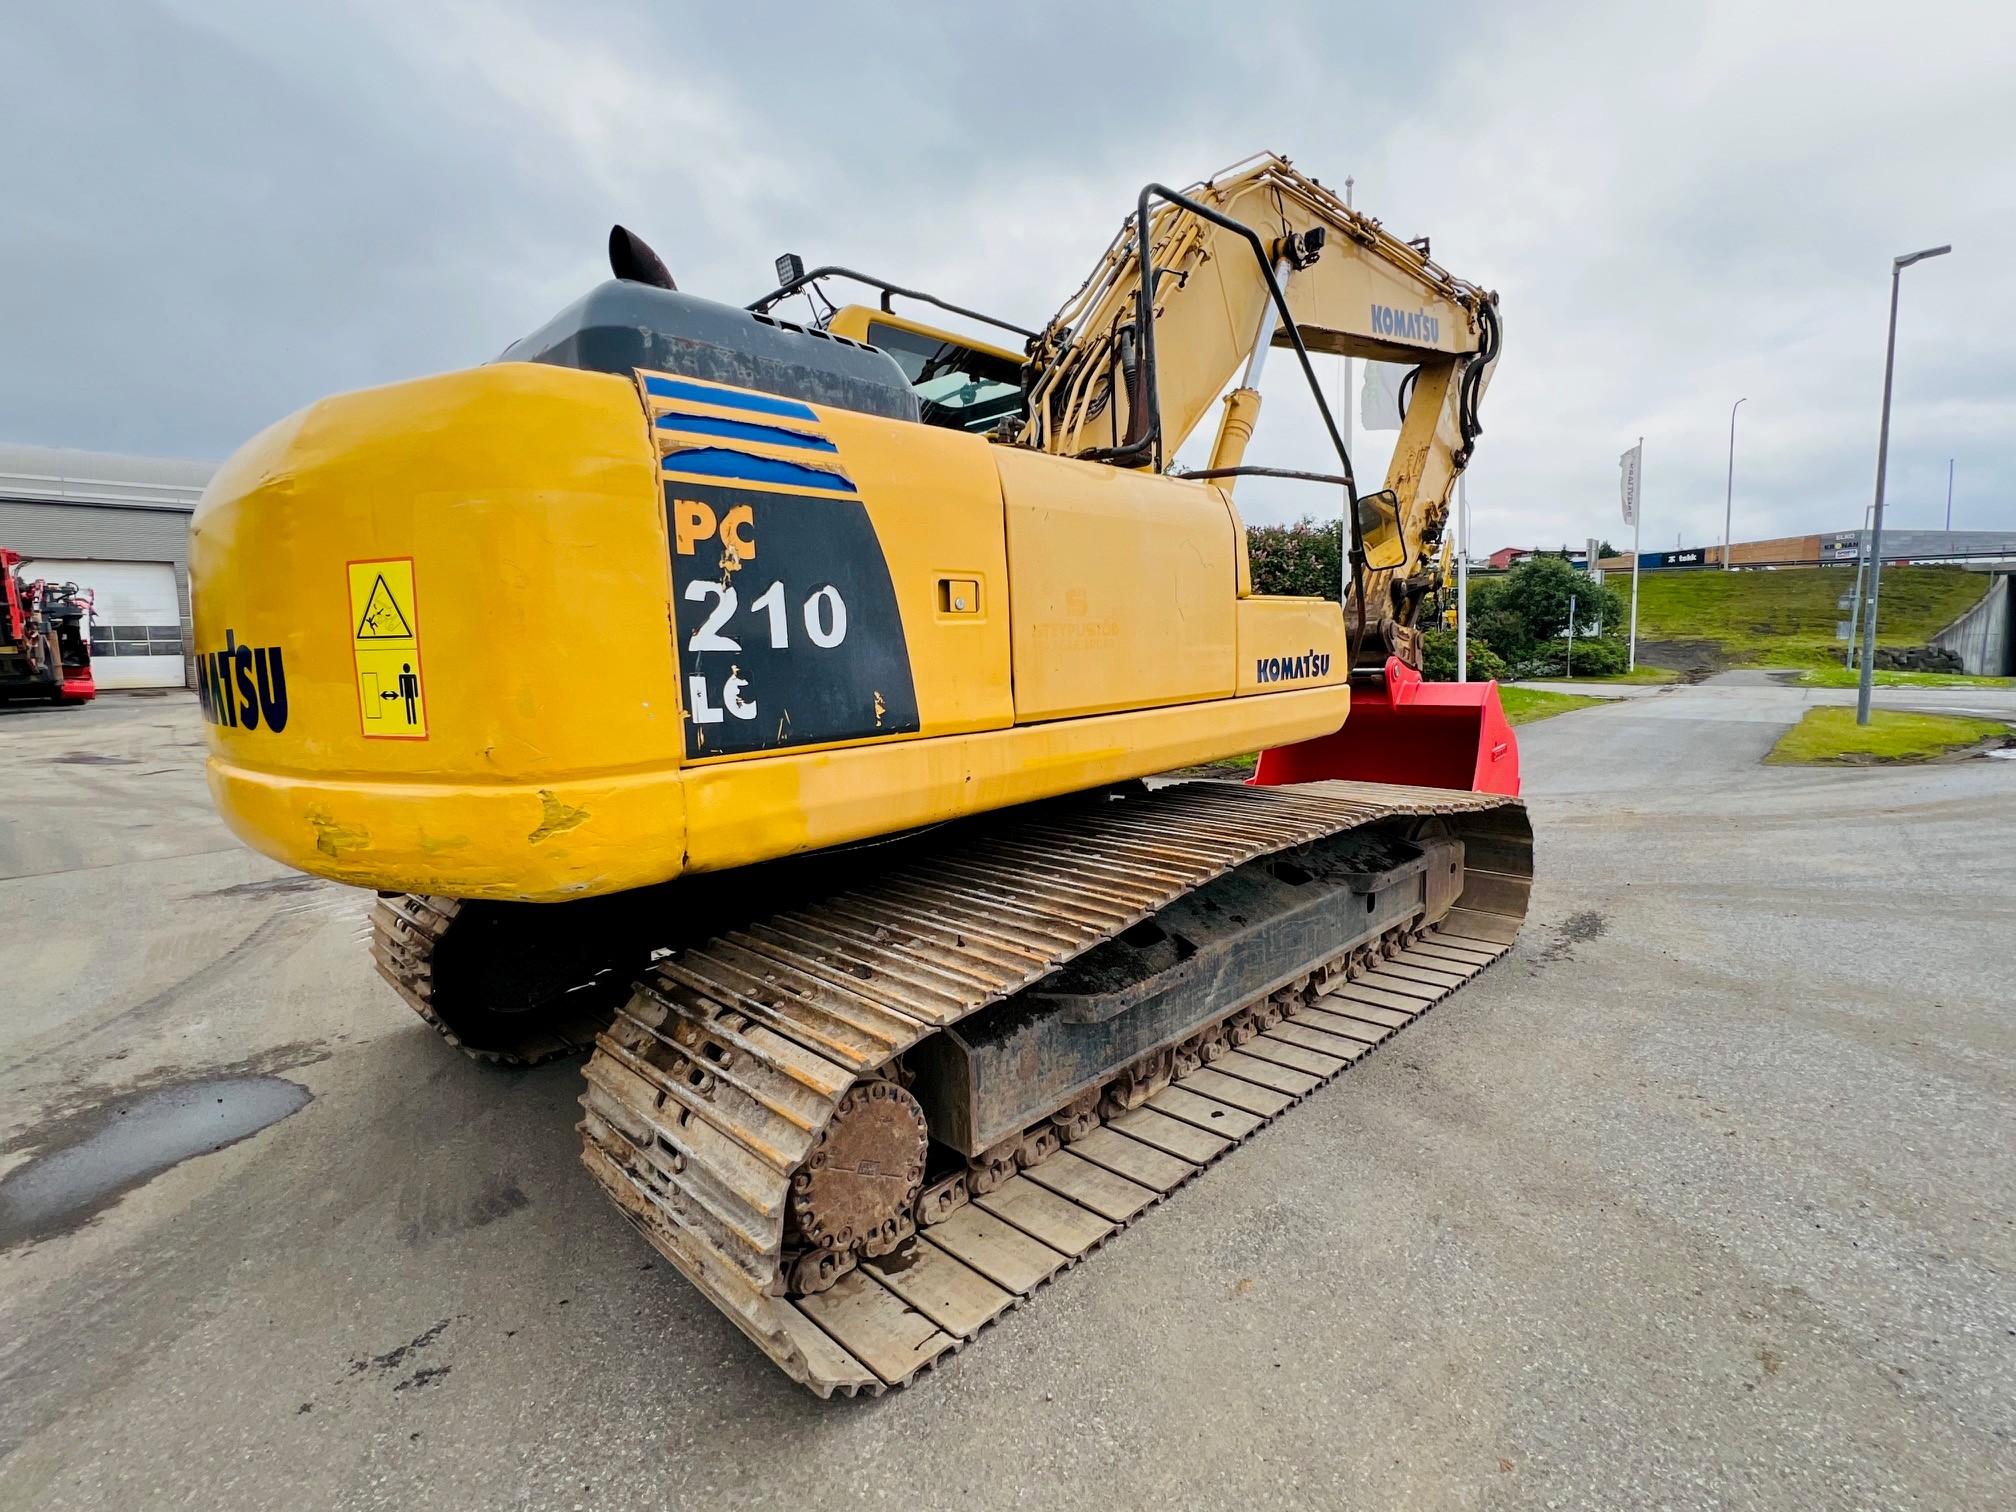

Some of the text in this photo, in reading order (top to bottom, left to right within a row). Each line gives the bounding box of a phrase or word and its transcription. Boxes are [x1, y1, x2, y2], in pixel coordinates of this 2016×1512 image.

[1371, 304, 1439, 344] KOMATSU
[674, 499, 756, 560] PC
[685, 580, 847, 652] 210
[1257, 649, 1330, 684] KOMATSU
